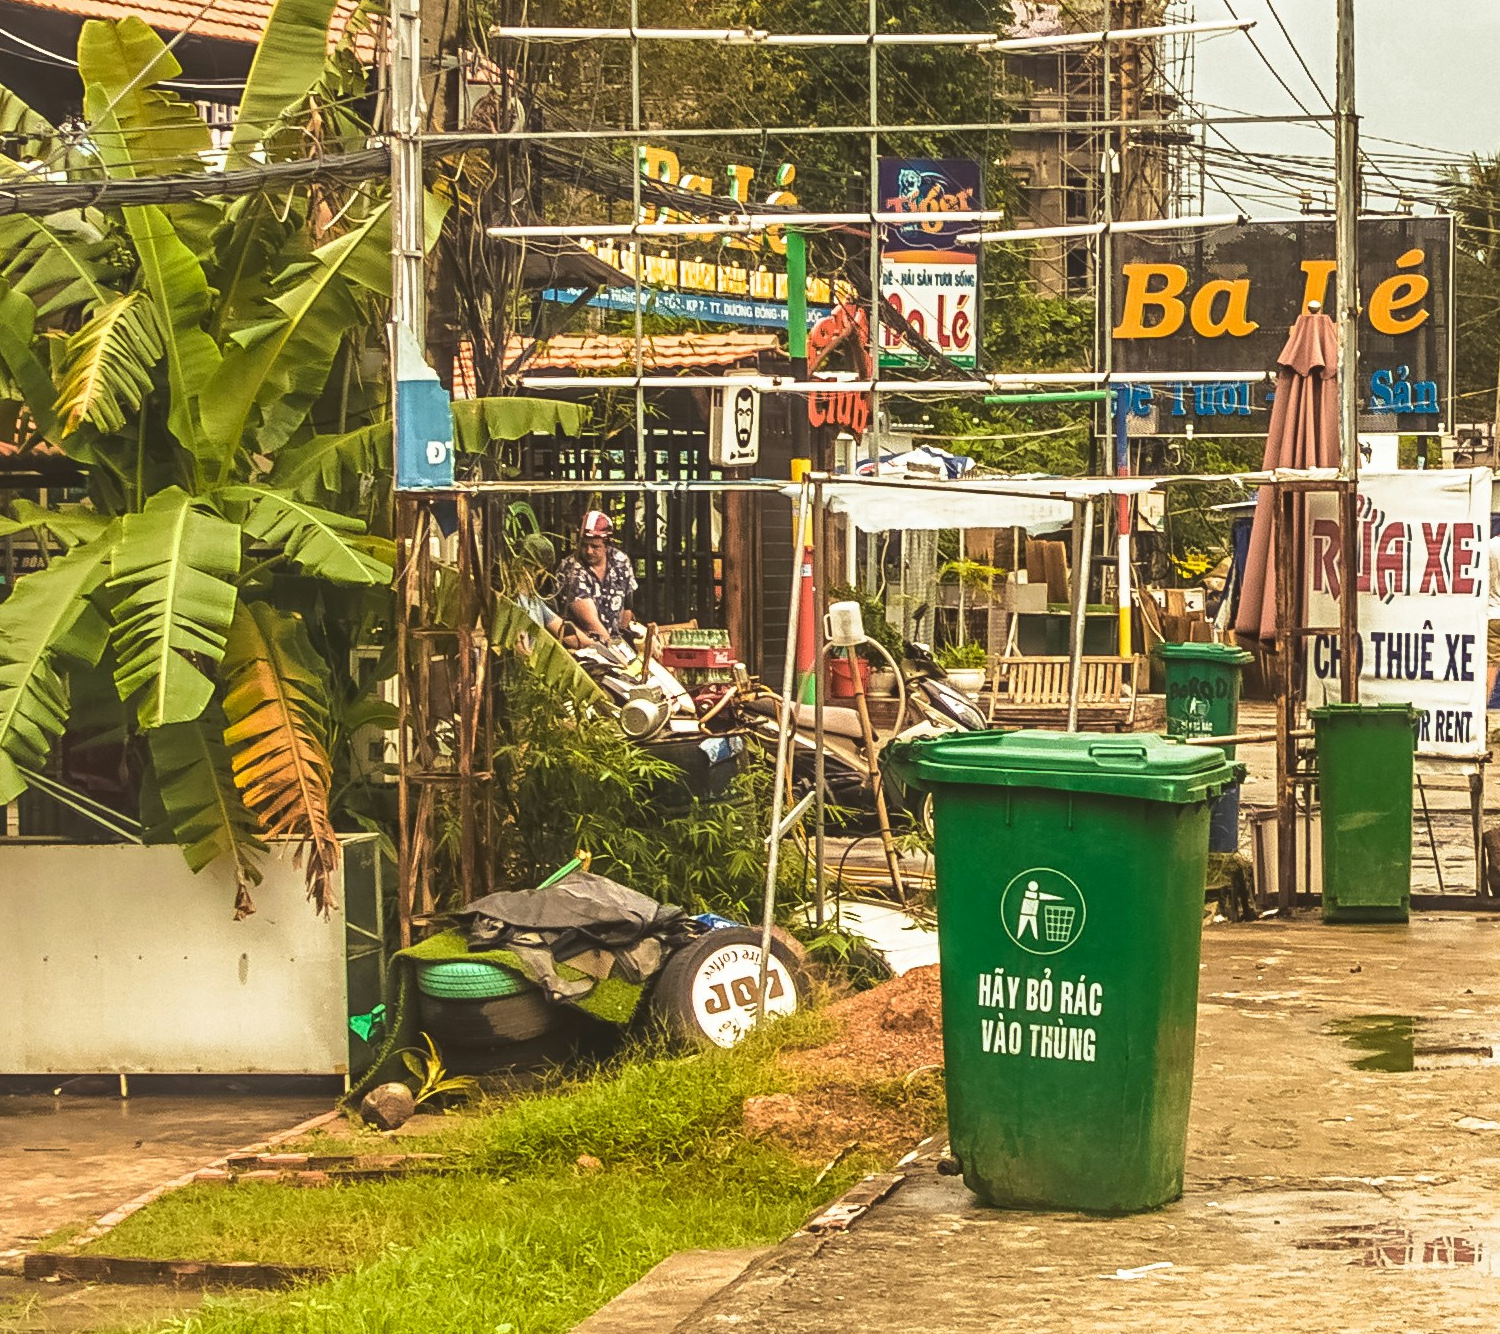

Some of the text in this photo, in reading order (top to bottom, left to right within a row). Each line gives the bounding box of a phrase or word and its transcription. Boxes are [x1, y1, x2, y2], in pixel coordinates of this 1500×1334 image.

[937, 293, 972, 351] Lé
[1112, 263, 1259, 338] Ba
[1371, 365, 1440, 414] Sản
[1420, 522, 1481, 597] XE
[1371, 620, 1434, 680] THUÊ
[1445, 634, 1476, 681] XE
[1436, 710, 1473, 743] RENT
[978, 968, 1103, 1016] HÃY BỎ RÁC
[981, 1012, 1096, 1062] VÀO THÙNG
